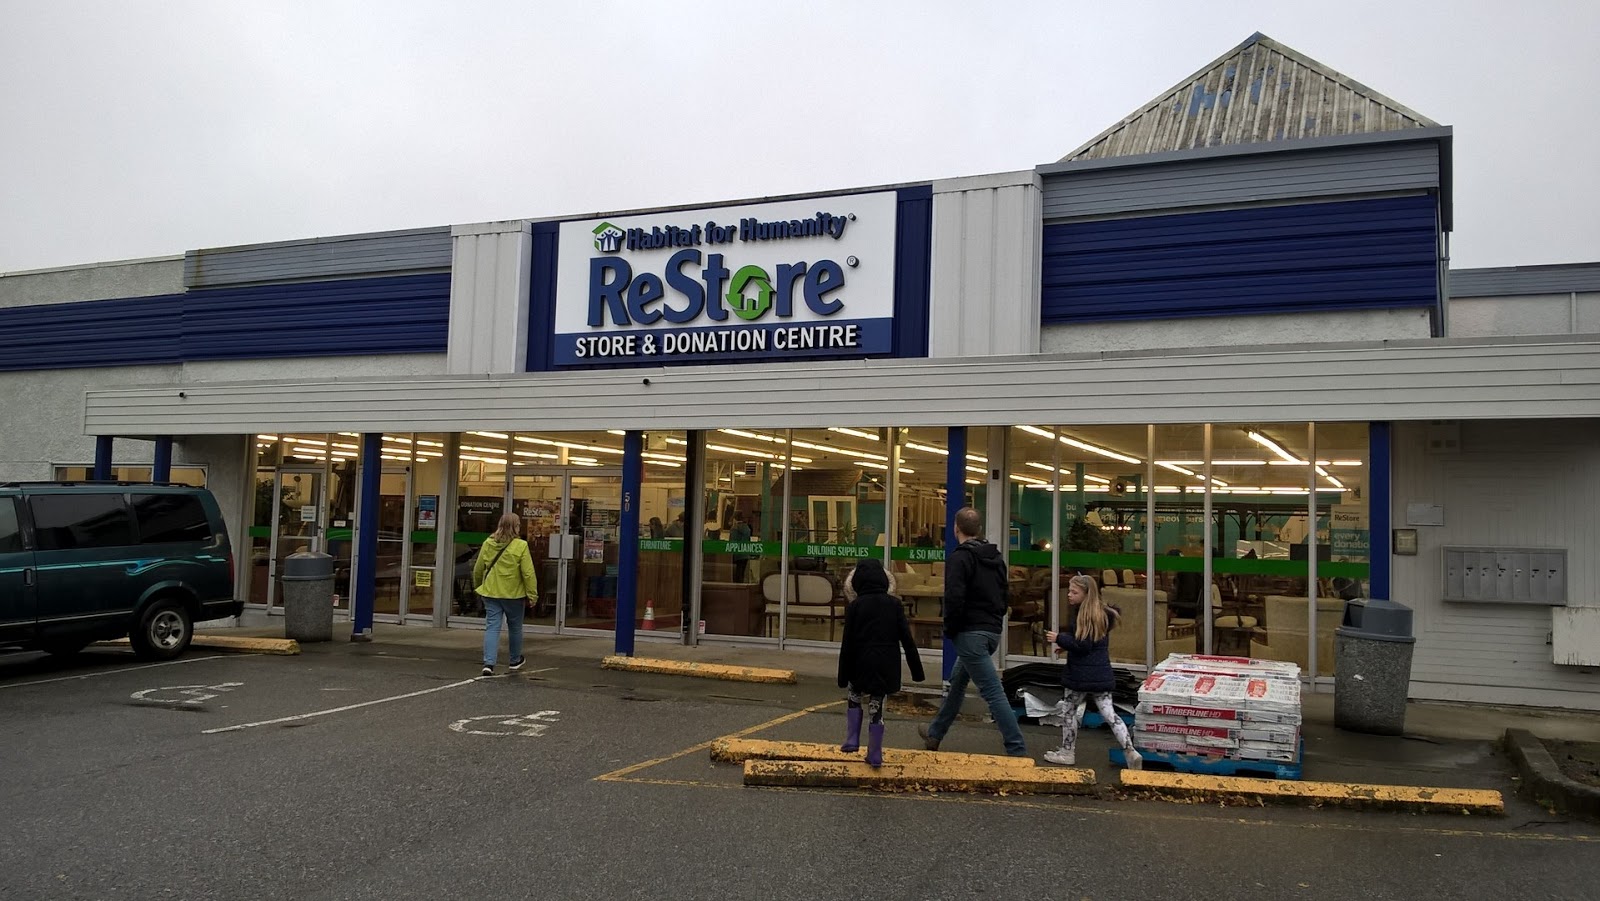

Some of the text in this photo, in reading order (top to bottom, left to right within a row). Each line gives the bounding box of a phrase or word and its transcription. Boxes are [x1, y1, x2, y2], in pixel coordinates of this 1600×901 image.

[626, 211, 847, 251] Habitat for Humanity
[587, 249, 845, 327] ReStore
[575, 325, 858, 358] STORE & DONATION CENTRE
[640, 540, 672, 550] FURNITURE
[725, 542, 763, 554] APPLIANCES
[807, 545, 869, 558] BUILDING SUPPLIES
[1334, 541, 1369, 549] donatio
